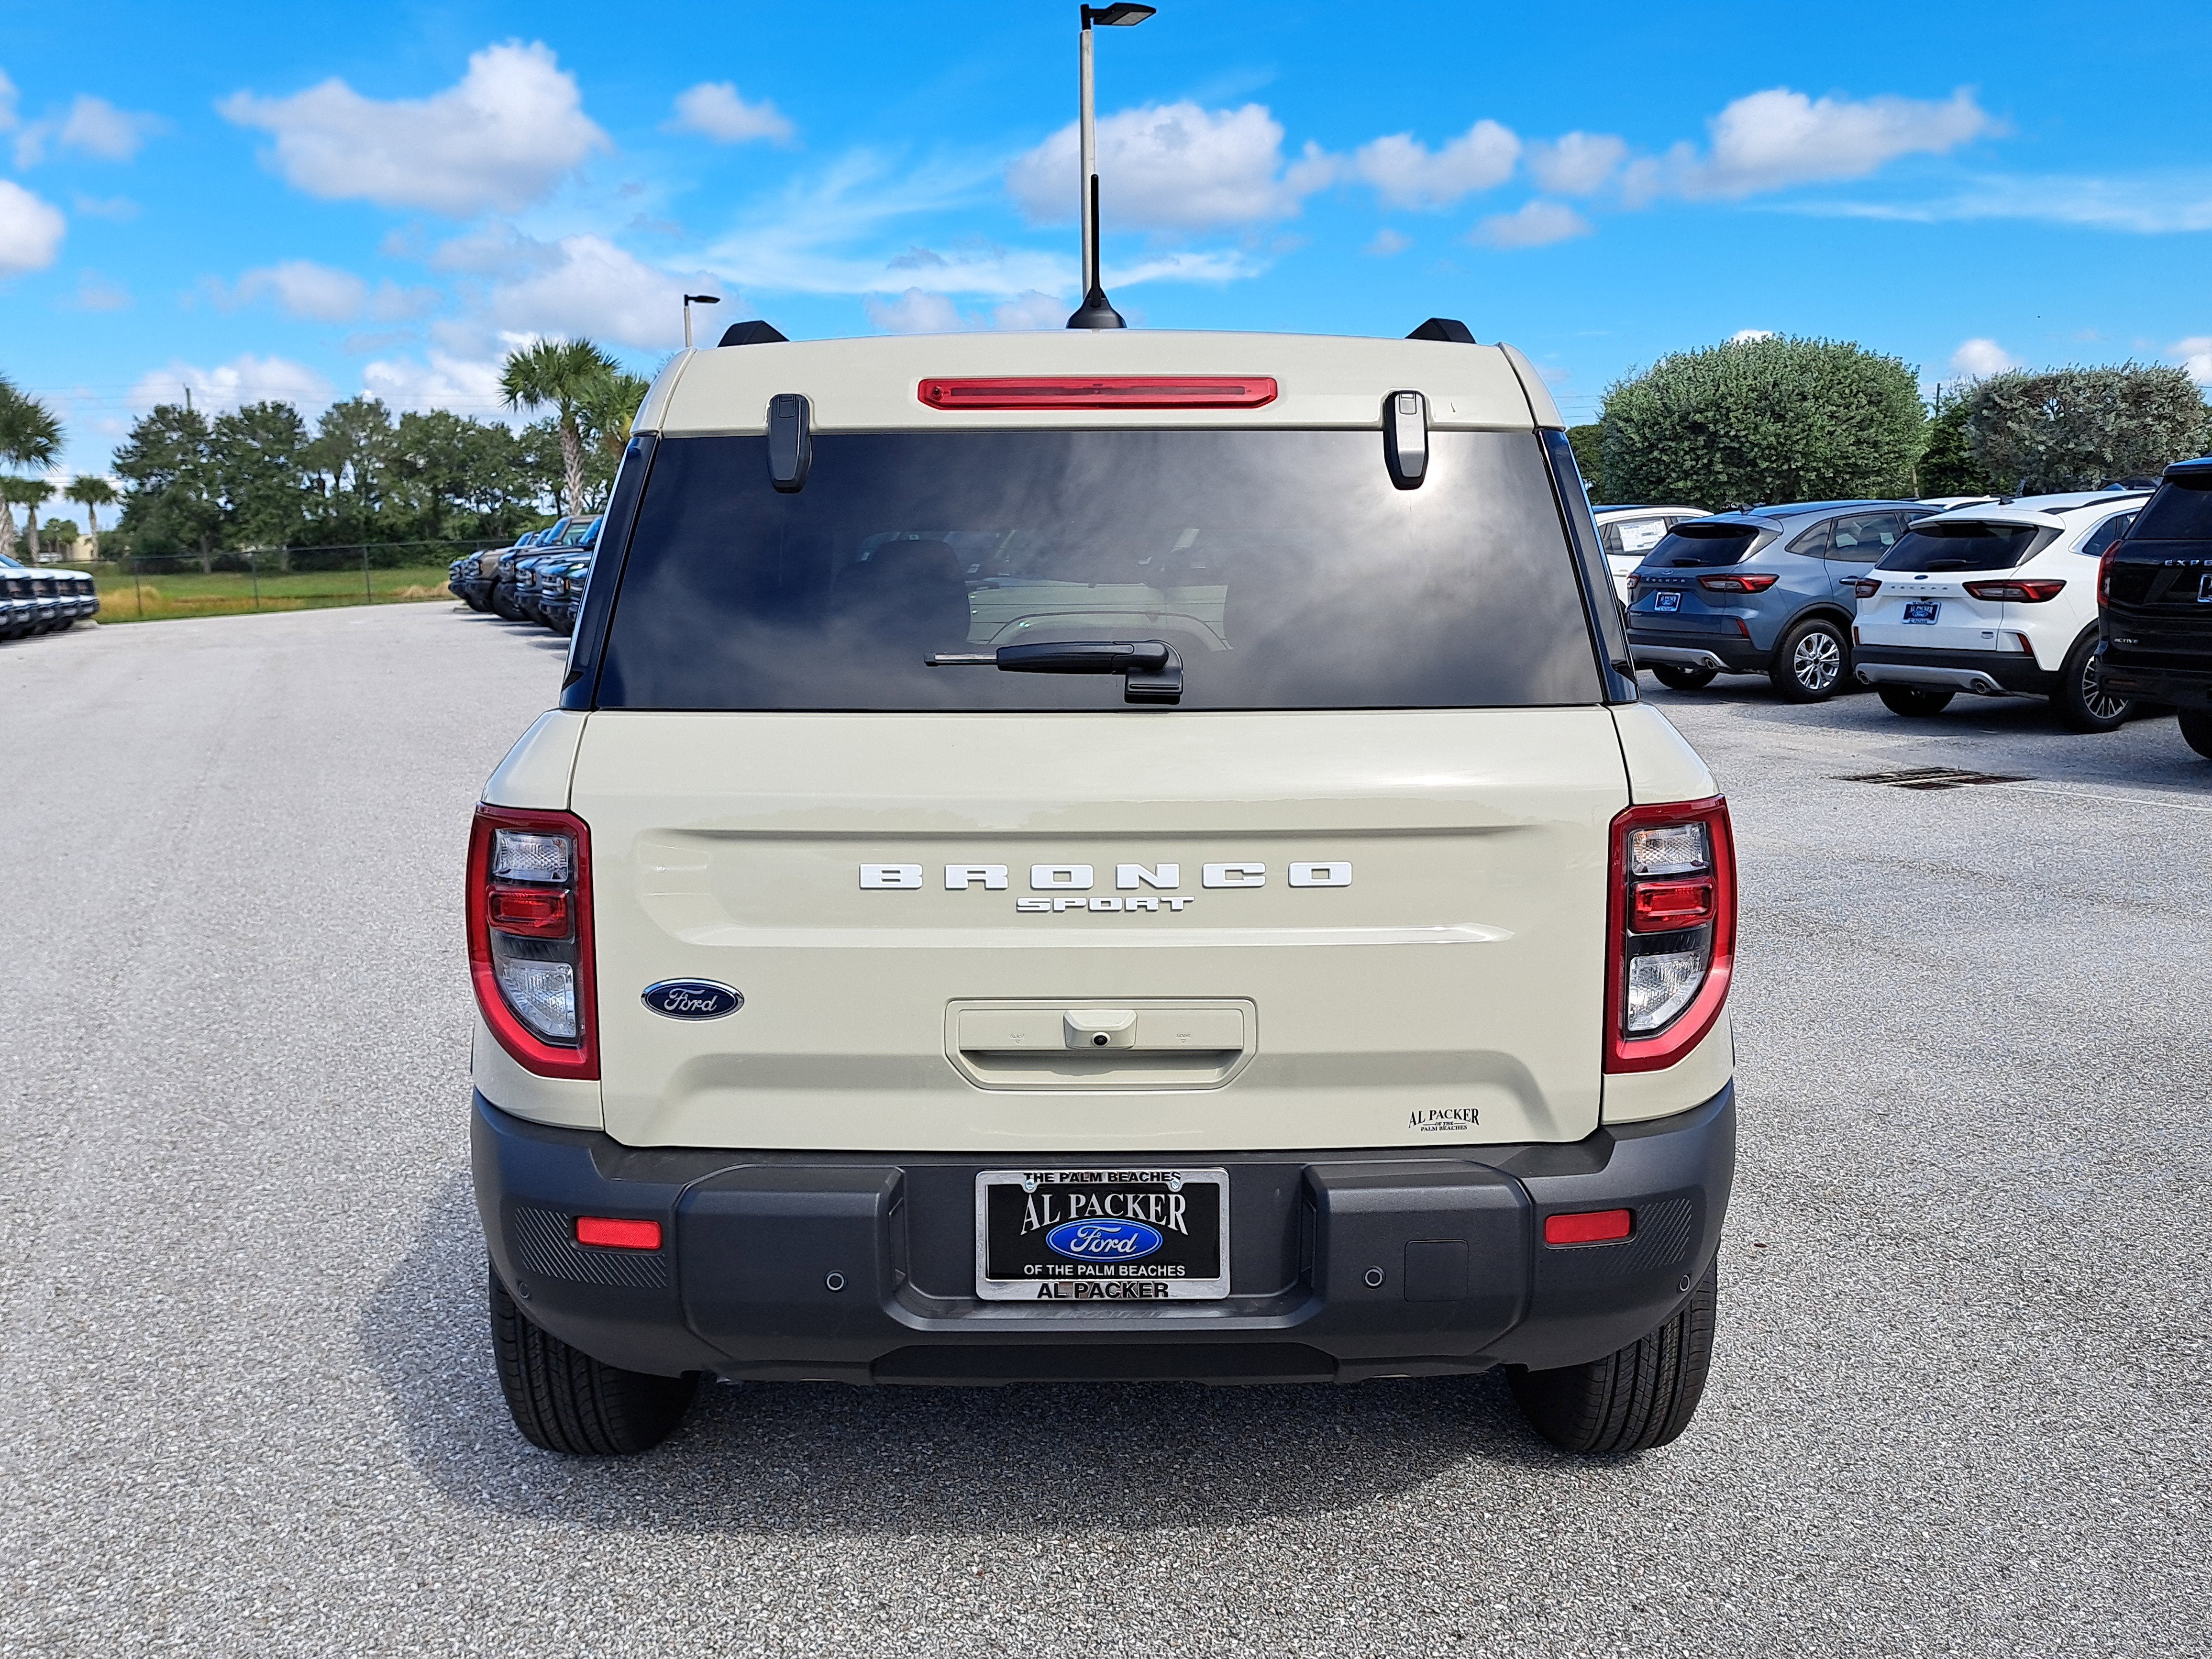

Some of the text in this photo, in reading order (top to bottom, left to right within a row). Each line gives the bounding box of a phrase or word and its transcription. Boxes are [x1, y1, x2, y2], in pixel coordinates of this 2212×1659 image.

[859, 861, 1353, 890] BRONCO
[1016, 896, 1195, 913] SPORT
[664, 988, 719, 1011] Ford
[1408, 1108, 1480, 1129] AL PACKER
[1023, 1171, 1182, 1183] THE PALM BEACHES
[1019, 1193, 1189, 1236] AL PACKER
[1070, 1225, 1139, 1253] Ford
[1024, 1264, 1185, 1277] OF THE PALM BEACHES
[1037, 1281, 1170, 1299] AL PACKER
